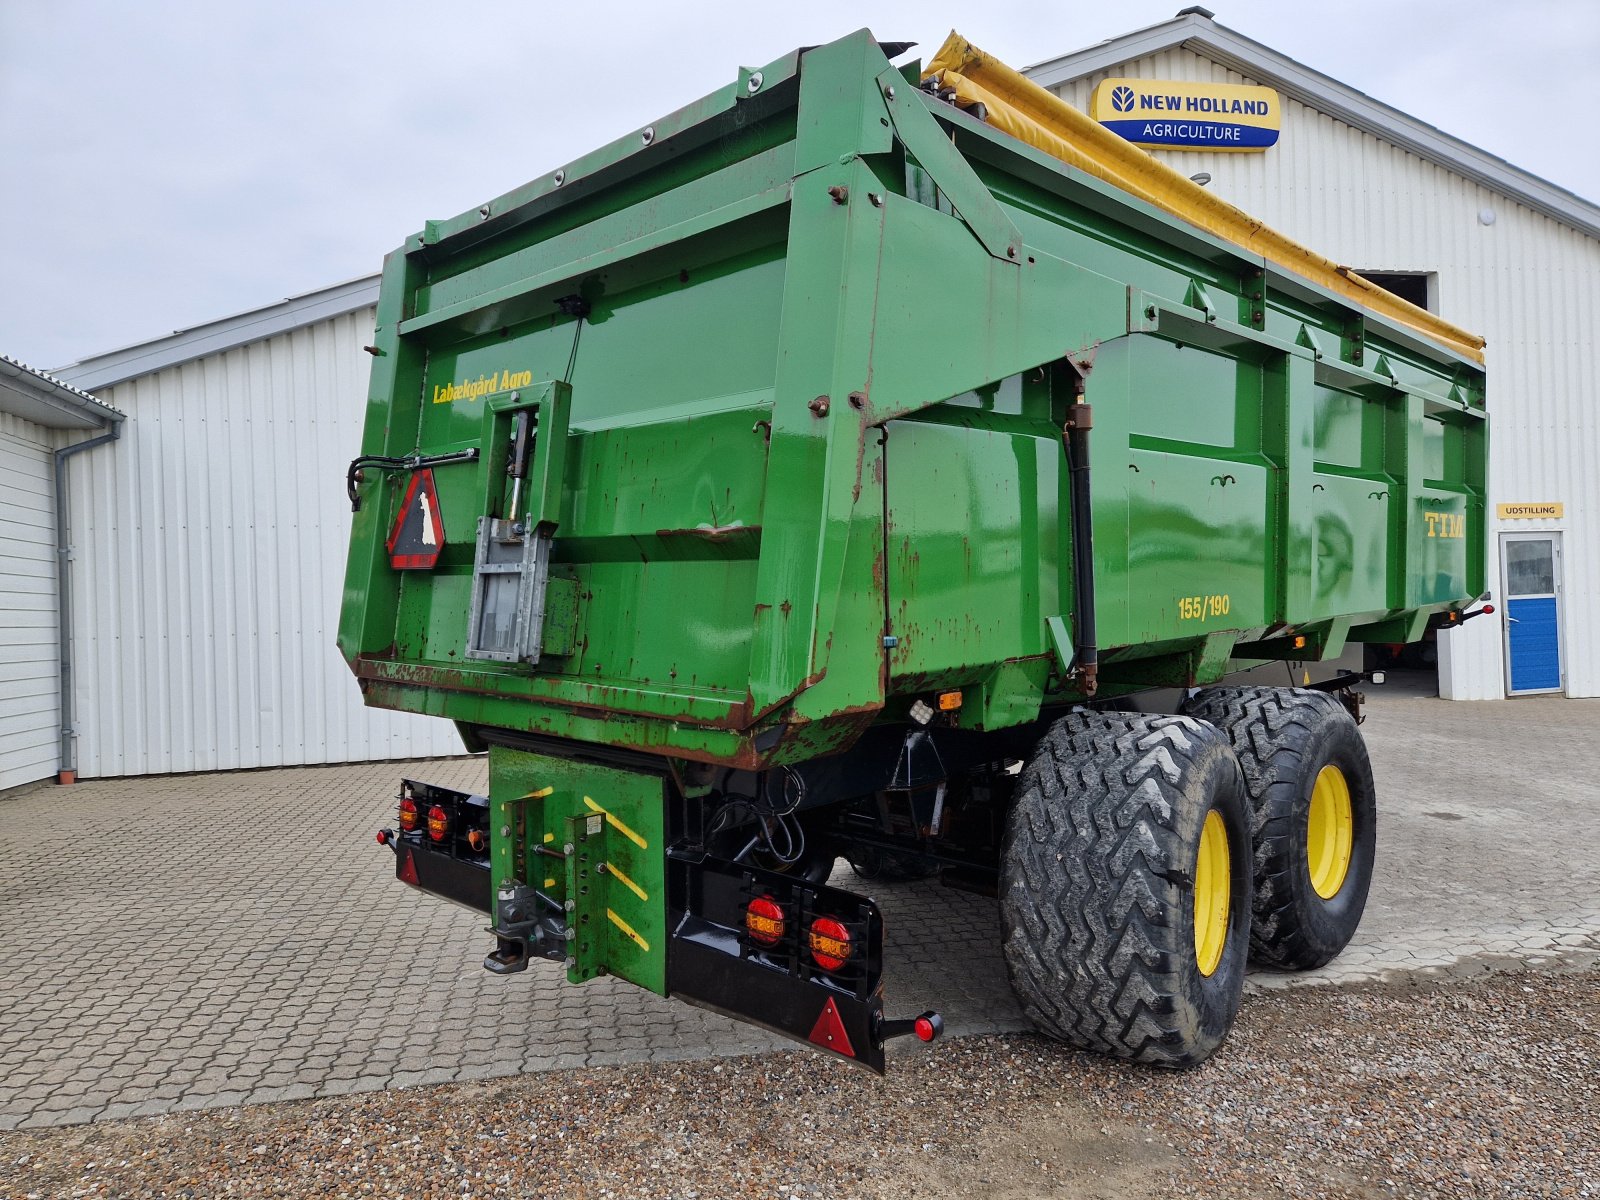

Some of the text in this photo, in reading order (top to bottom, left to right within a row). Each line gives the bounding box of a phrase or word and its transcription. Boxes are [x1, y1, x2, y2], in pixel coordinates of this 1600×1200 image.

[1140, 94, 1268, 116] NEW HOLLAND
[1143, 123, 1240, 141] AGRICULTURE
[433, 372, 498, 404] Labækgård
[1505, 506, 1555, 515] UDSTILLING
[1424, 511, 1464, 538] TIM
[1178, 594, 1230, 622] 155/190
